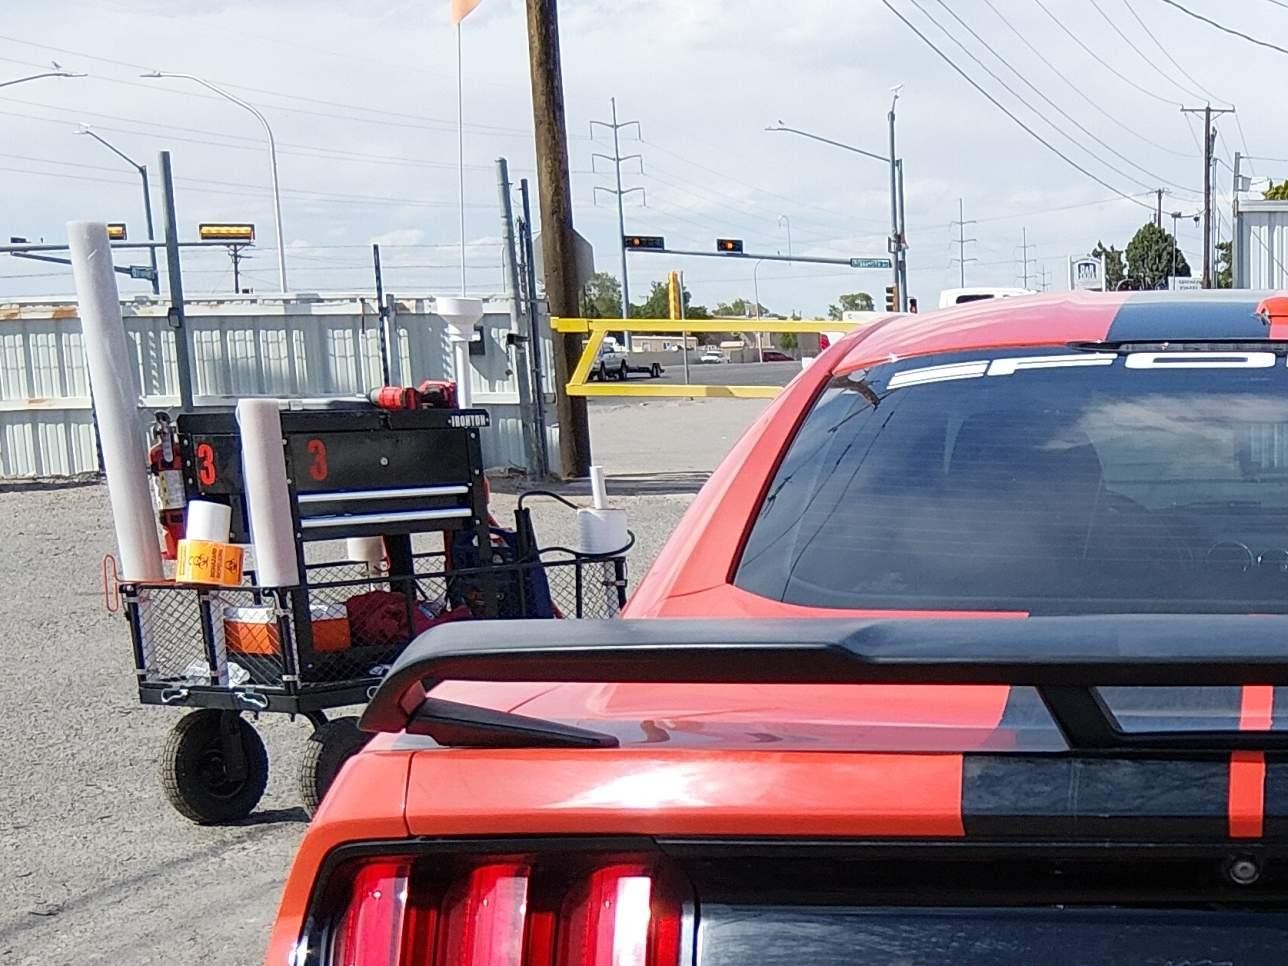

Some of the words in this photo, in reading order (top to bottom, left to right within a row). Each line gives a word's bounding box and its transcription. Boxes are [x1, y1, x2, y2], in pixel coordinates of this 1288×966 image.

[451, 414, 486, 427] IRONTON
[197, 443, 216, 486] 3
[307, 439, 327, 480] 3
